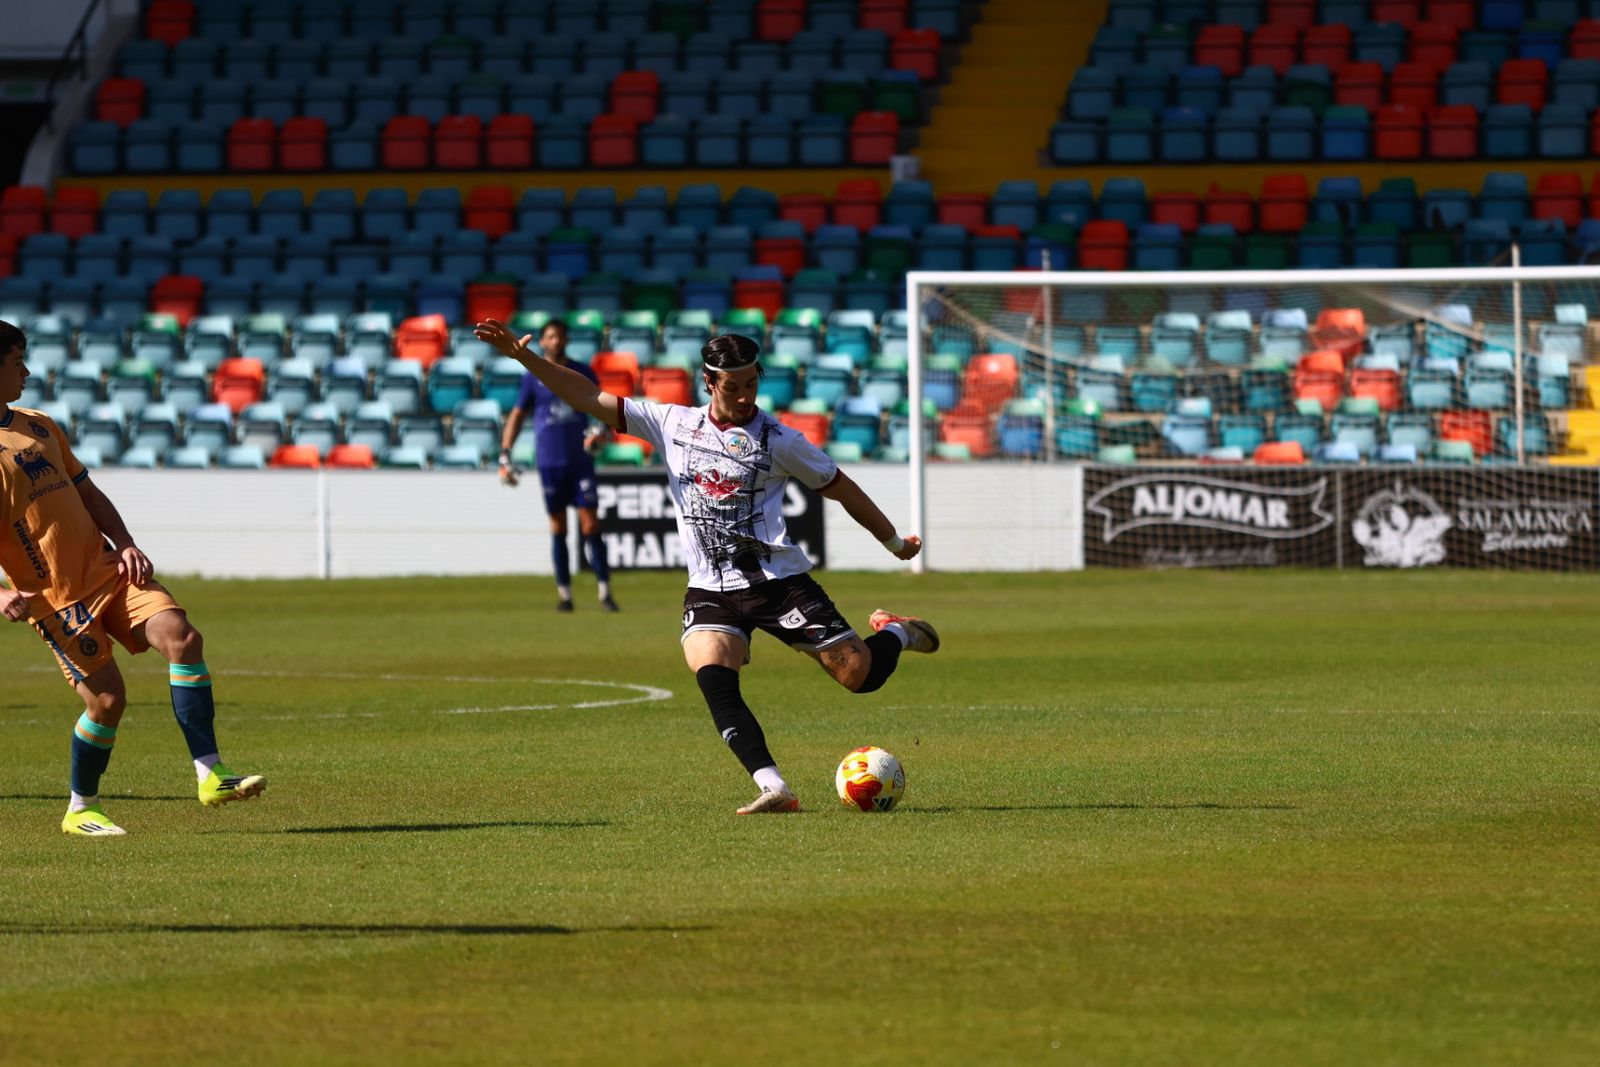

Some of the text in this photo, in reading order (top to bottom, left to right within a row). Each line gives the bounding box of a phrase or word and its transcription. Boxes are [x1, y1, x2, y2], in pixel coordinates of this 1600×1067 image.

[28, 480, 70, 501] plenitude
[1133, 485, 1290, 528] ALJOMAR
[1458, 510, 1592, 532] SALAMANCA
[14, 519, 47, 579] CANTABRIA
